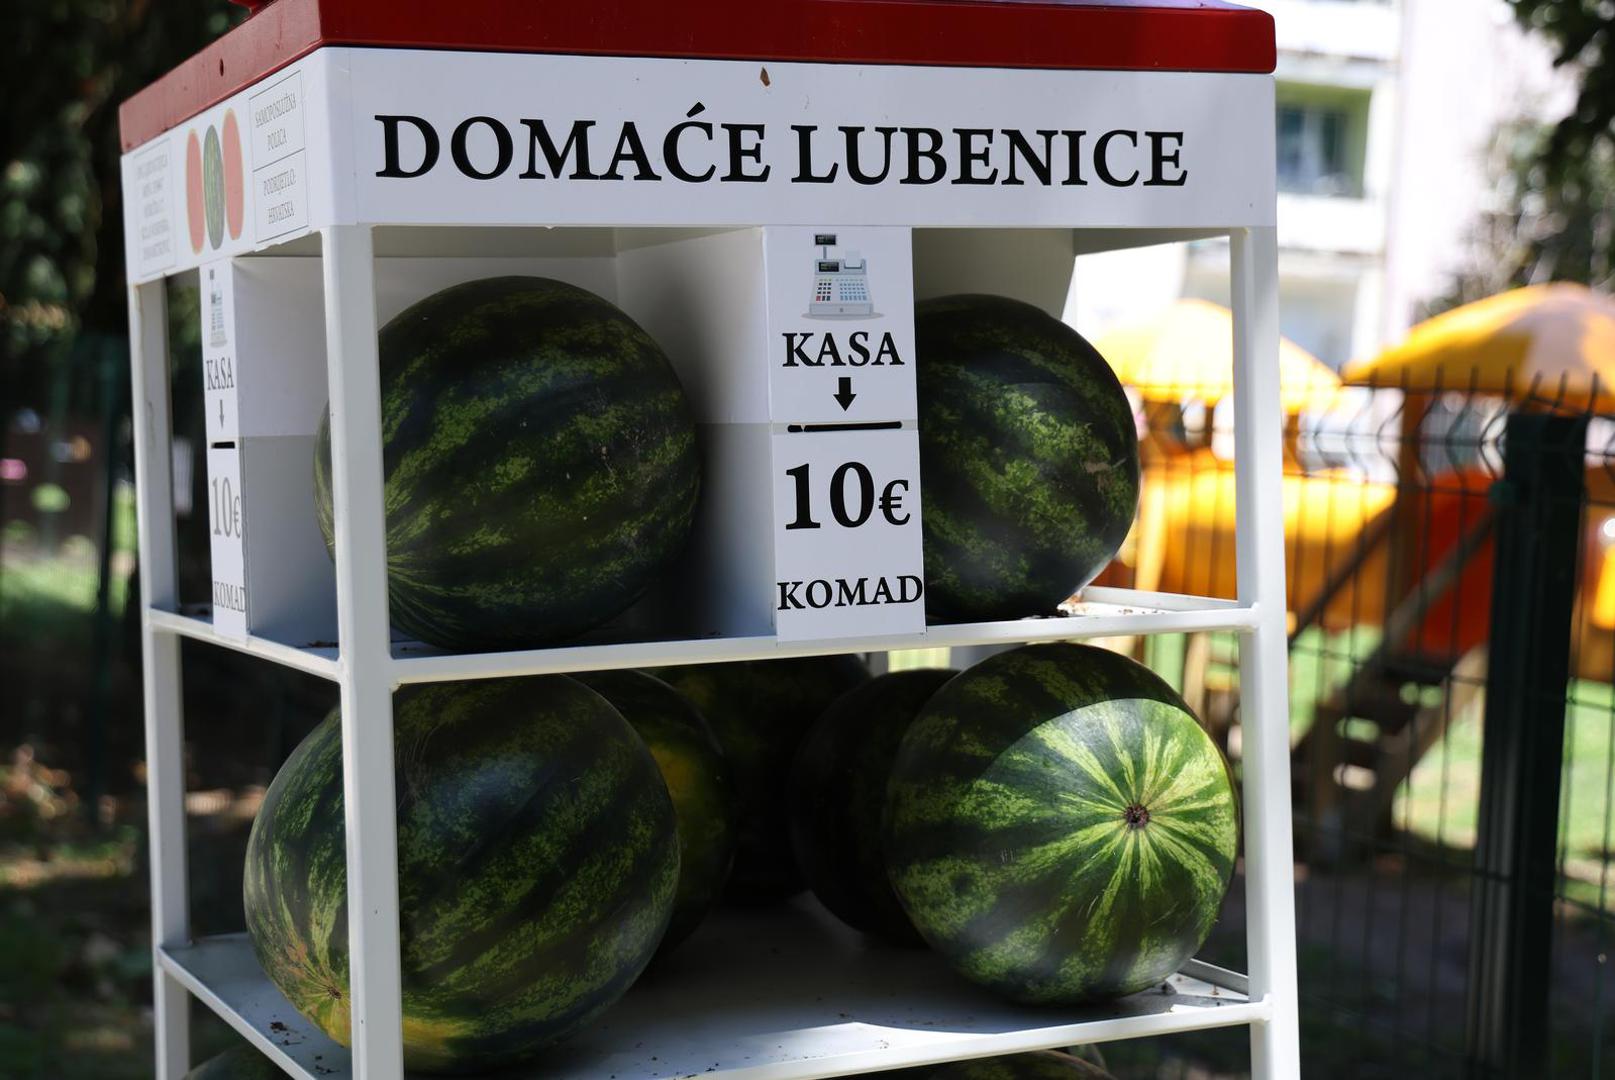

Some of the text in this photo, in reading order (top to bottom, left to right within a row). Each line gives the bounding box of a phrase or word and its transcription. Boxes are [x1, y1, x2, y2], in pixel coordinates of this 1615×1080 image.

[374, 101, 1188, 187] DOMAĆE LUBENICE
[782, 331, 905, 367] KASA
[206, 357, 234, 391] KASA
[212, 477, 242, 538] 10€
[785, 461, 911, 530] 10€
[214, 581, 246, 613] KOMAD
[777, 575, 923, 610] KOMAD
